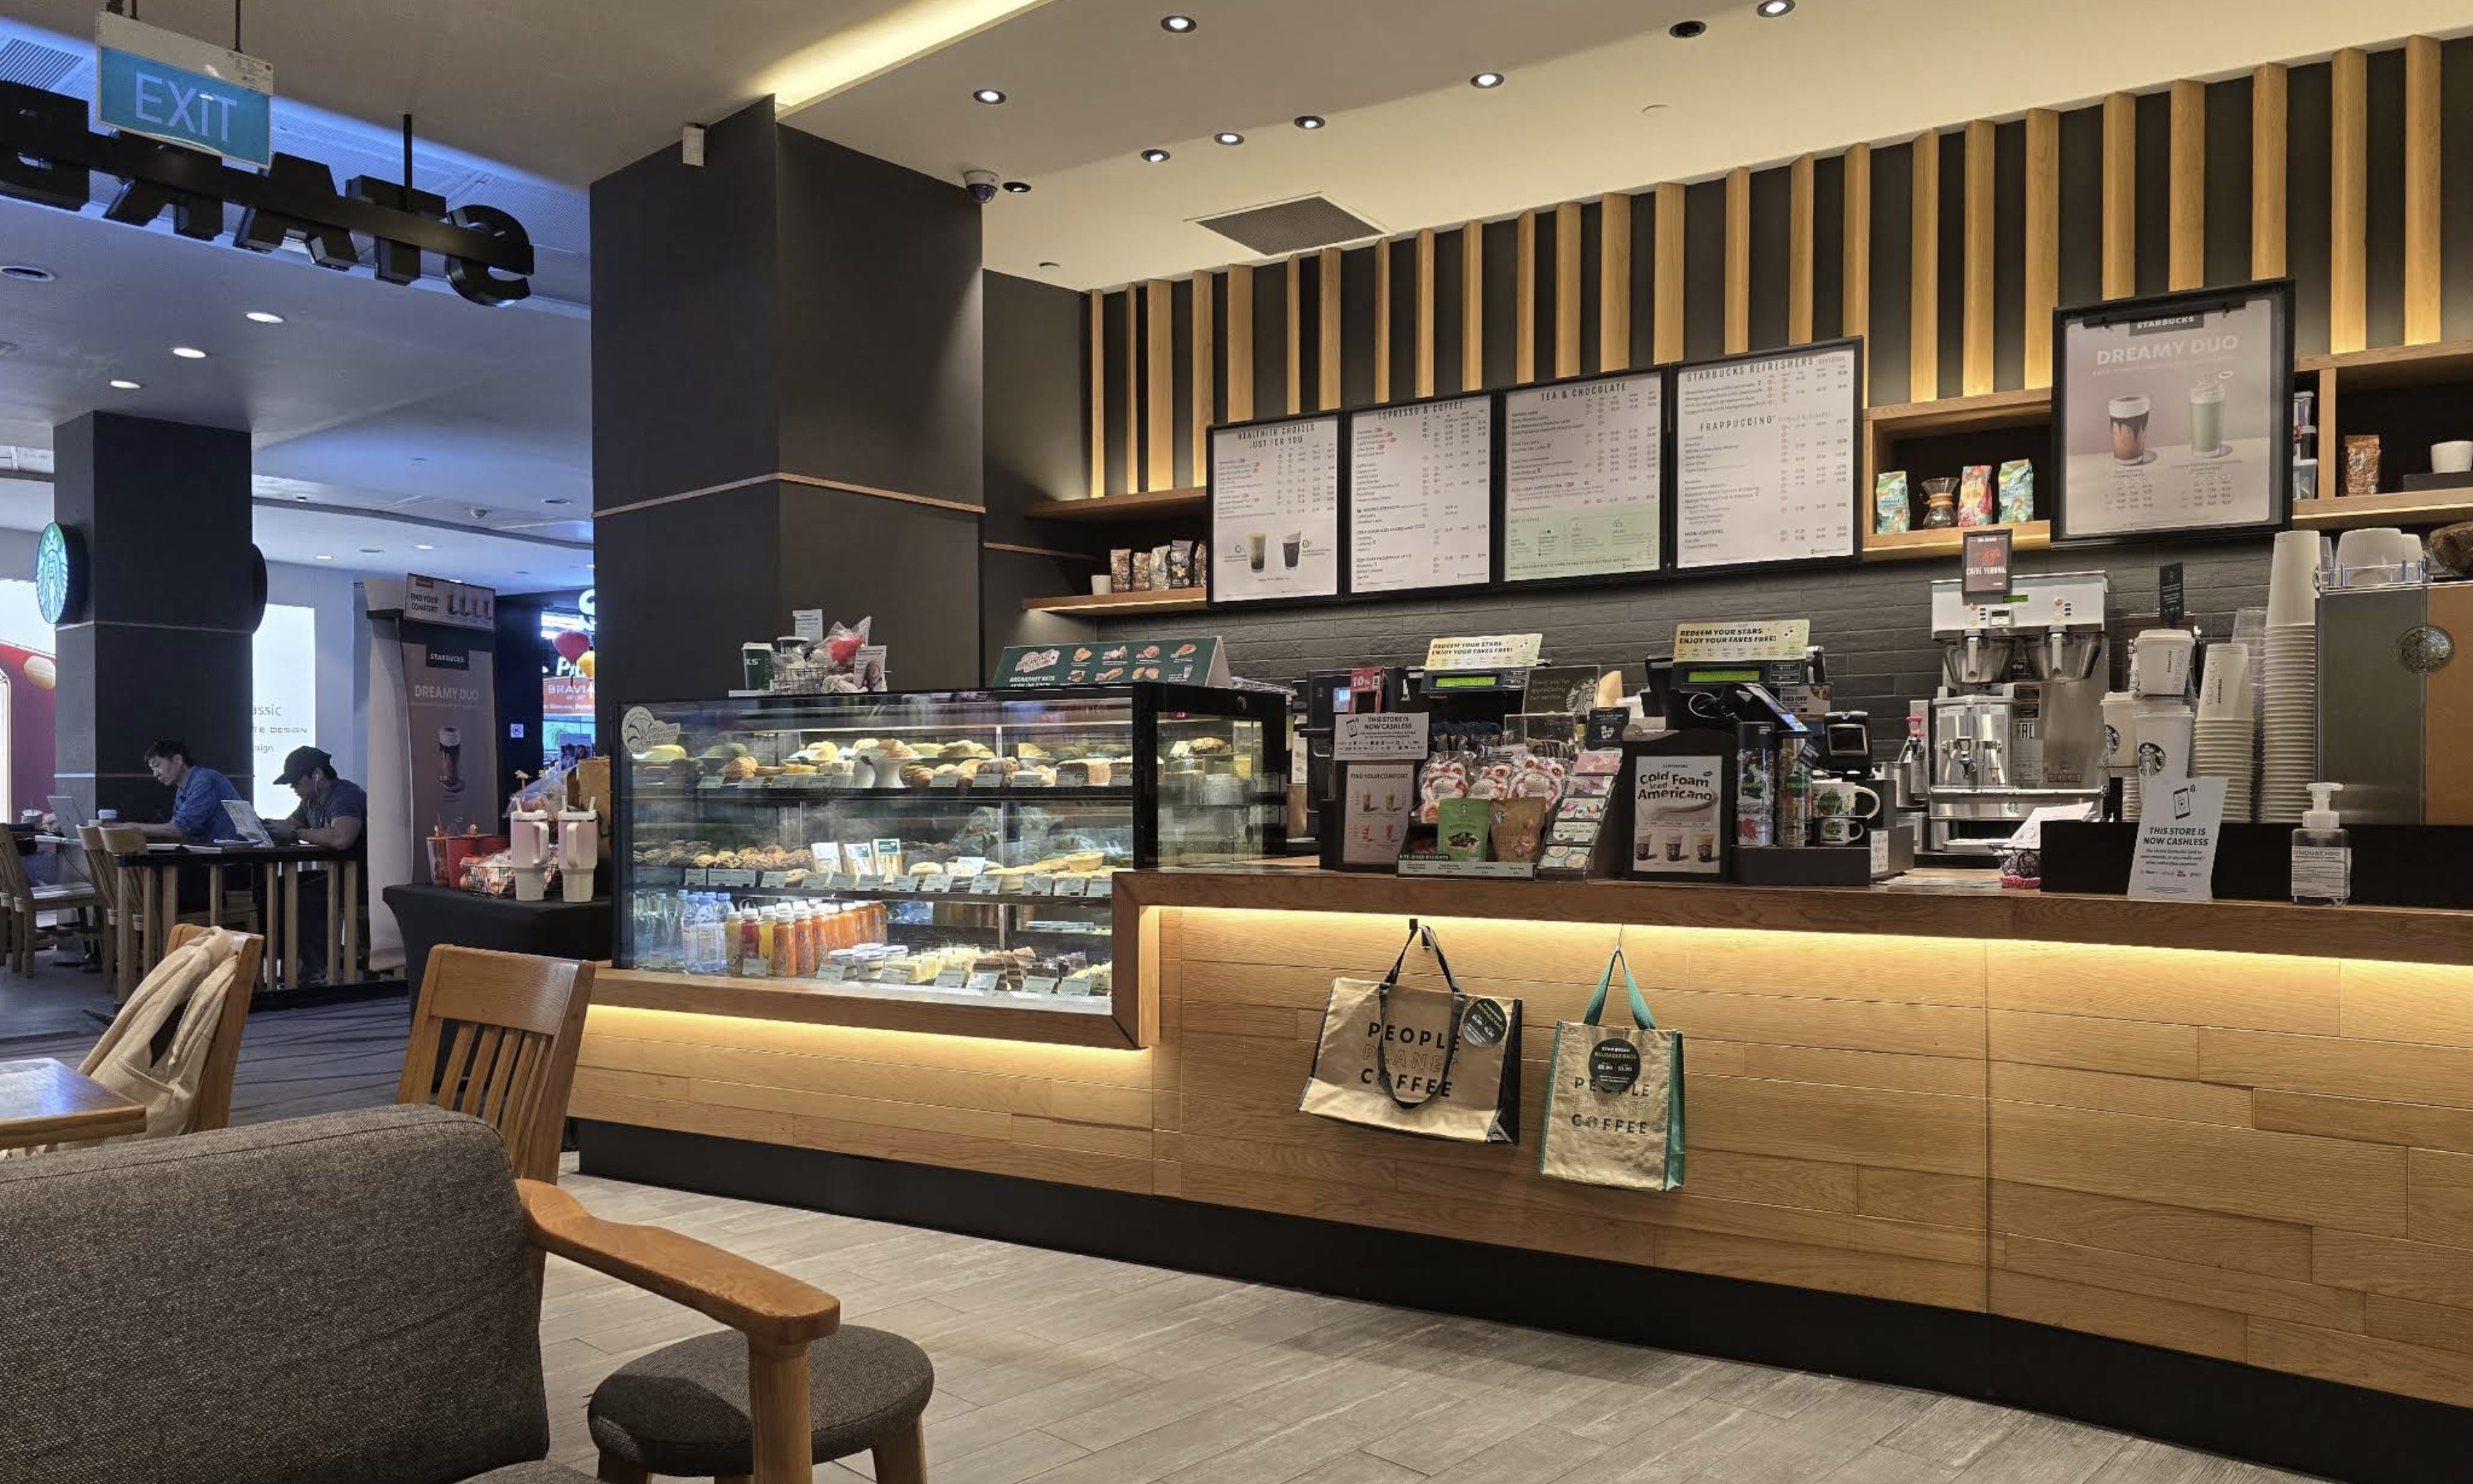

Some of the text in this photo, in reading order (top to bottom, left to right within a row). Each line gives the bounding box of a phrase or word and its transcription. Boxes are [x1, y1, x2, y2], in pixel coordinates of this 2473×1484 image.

[136, 72, 239, 142] EXIT
[2137, 316, 2194, 329] STARBUCKS
[2098, 335, 2238, 365] DREAMY DUO
[1687, 367, 1745, 382] STARBUCKS
[1750, 358, 1815, 373] REFRESHERS
[1541, 393, 1556, 401] TEA
[1572, 382, 1626, 397] CHOCOLATE
[1378, 406, 1419, 420] ESPRESSO
[1432, 401, 1463, 412] COFFEE
[1282, 424, 1315, 435] CHOICES
[1700, 415, 1772, 432] FRAPPUCCINO
[1288, 435, 1303, 444] YOU
[411, 602, 439, 613] COMFORT
[430, 653, 464, 663] STARBUCKS
[415, 685, 480, 700] DREAMY DUO
[252, 703, 282, 716] assic
[1639, 771, 1709, 787] Cold Foam
[1637, 786, 1712, 801] Americano
[2169, 827, 2197, 836] STORE
[2144, 837, 2209, 847] NOW CASHLESS
[1368, 1022, 1461, 1051] PEOPLE
[1360, 1068, 1452, 1098] CFFEE
[1574, 1076, 1649, 1097] PELE
